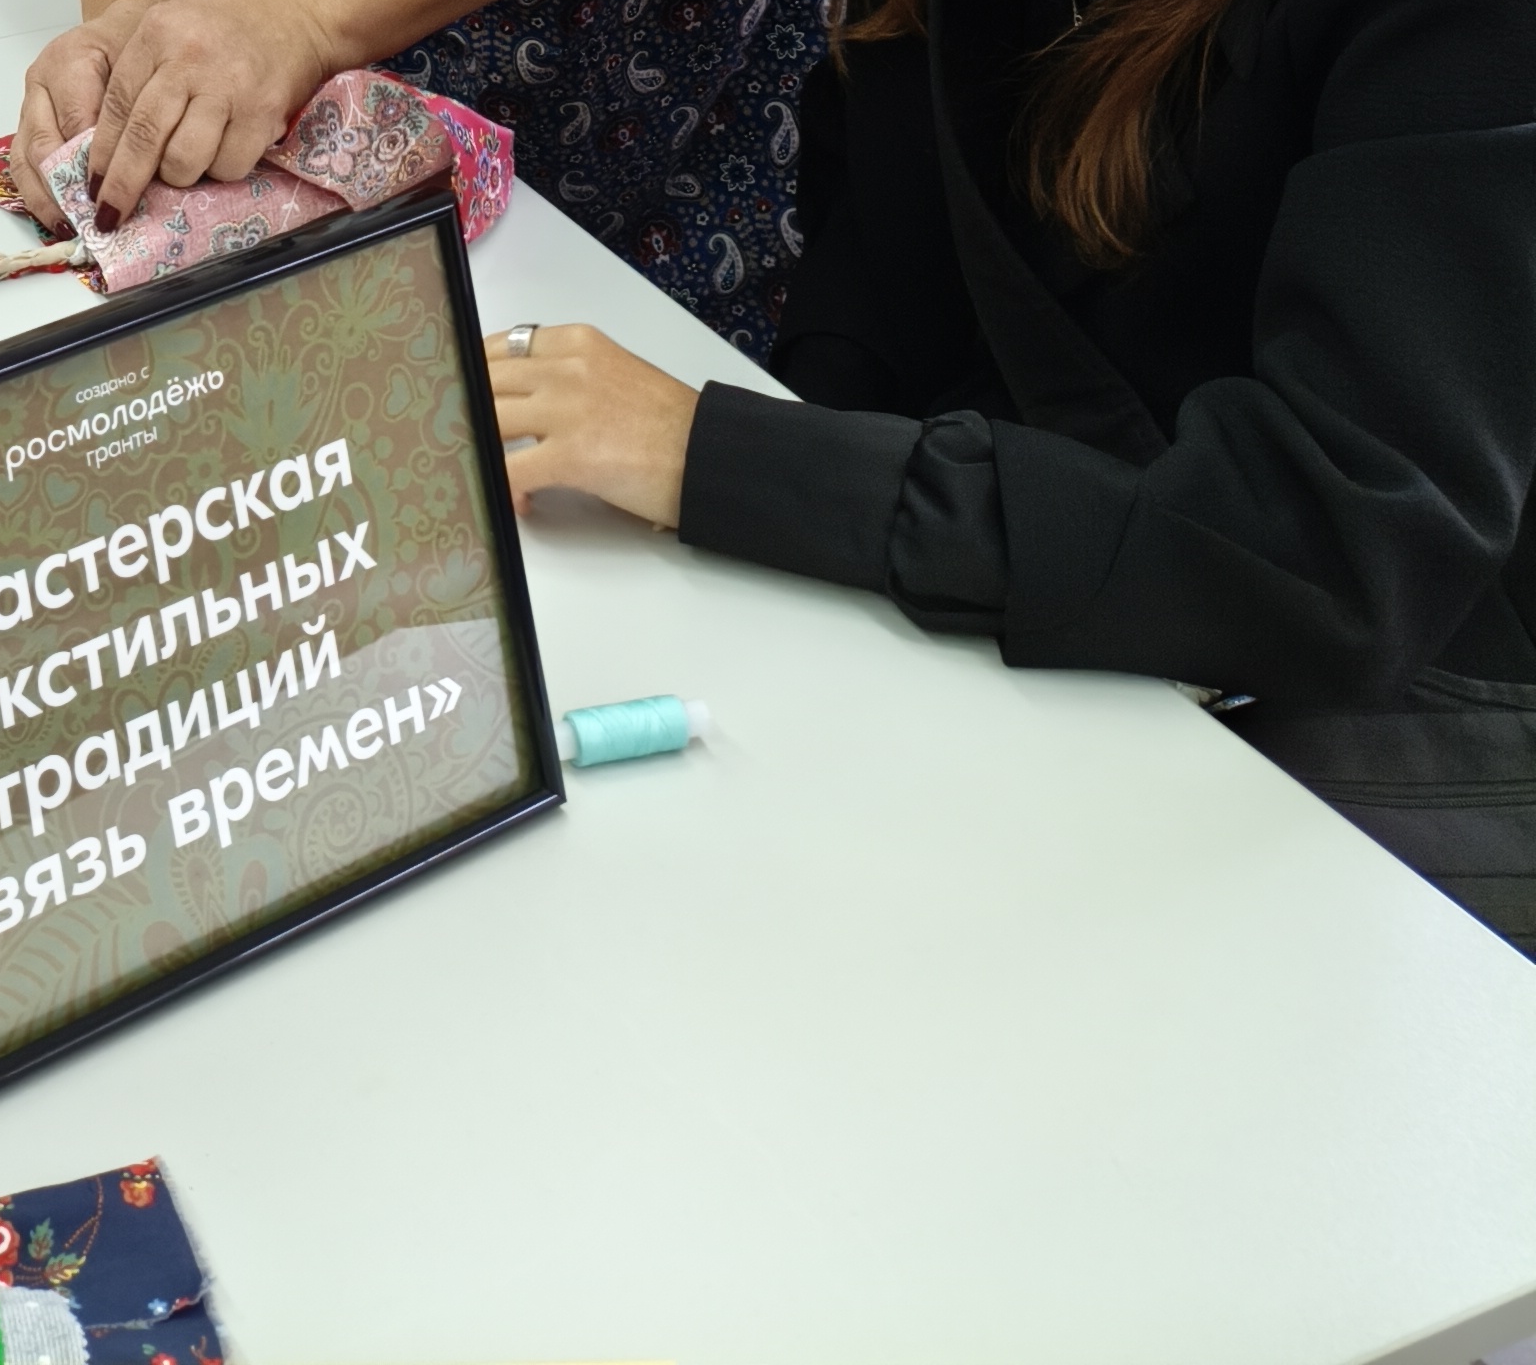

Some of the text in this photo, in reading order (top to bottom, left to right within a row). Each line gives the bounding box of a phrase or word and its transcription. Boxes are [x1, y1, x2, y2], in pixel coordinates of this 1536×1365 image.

[5, 369, 225, 482] росмолодёжь
[75, 371, 137, 404] создано
[85, 426, 158, 469] гранты
[167, 676, 463, 849] времен»
